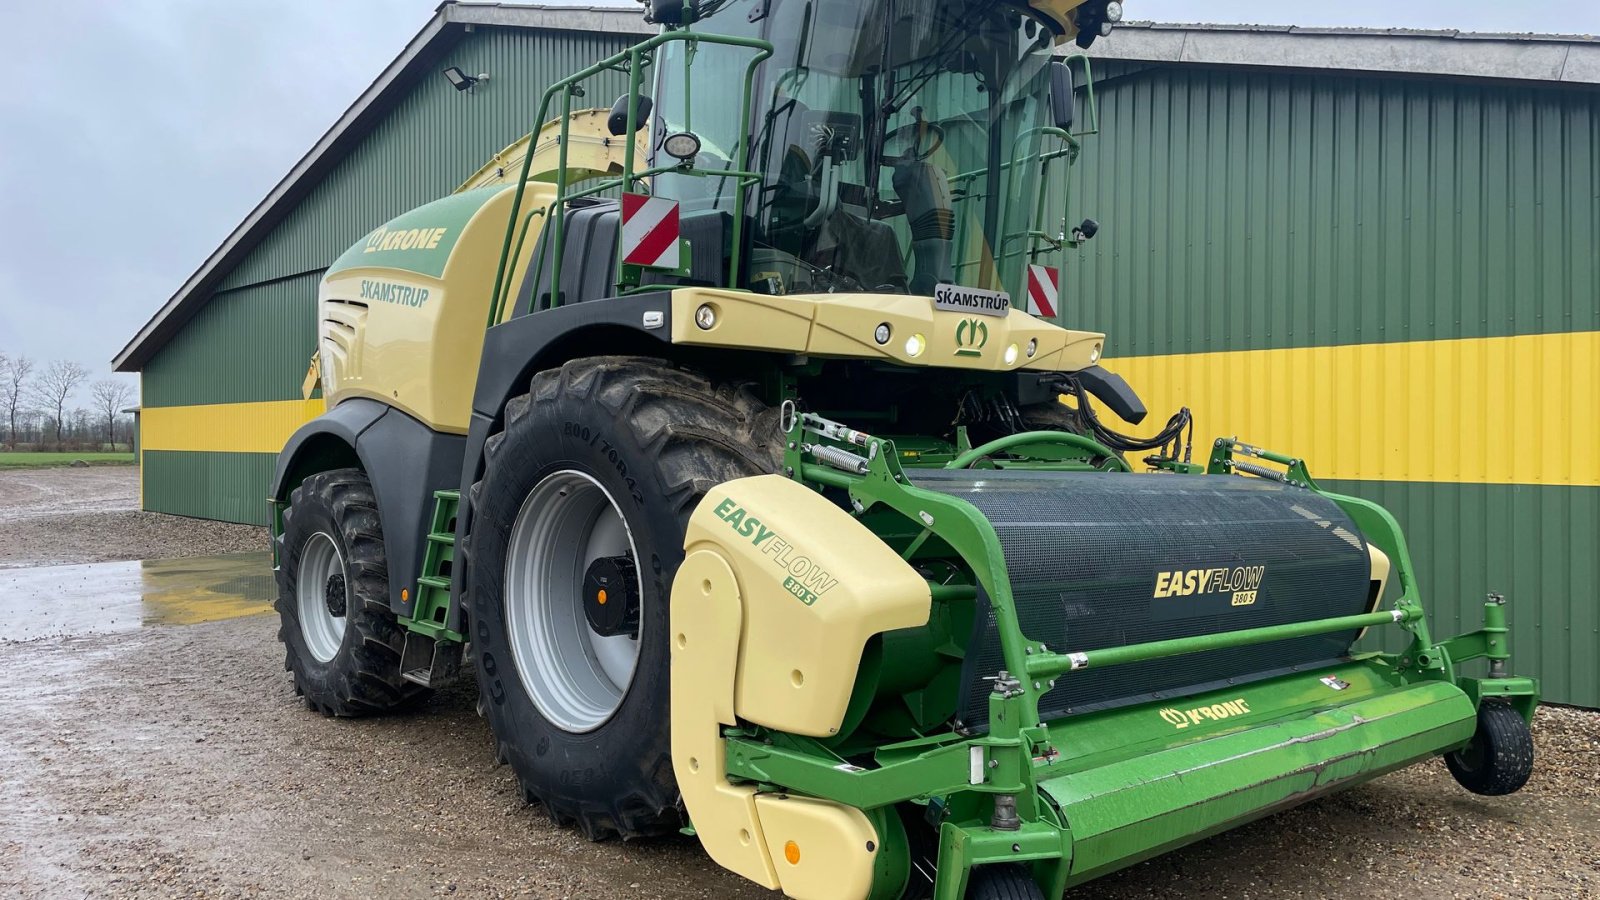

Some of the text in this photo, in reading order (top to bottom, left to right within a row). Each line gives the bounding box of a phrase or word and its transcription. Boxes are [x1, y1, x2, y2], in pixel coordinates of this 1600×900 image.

[377, 228, 447, 251] KRONE
[361, 279, 429, 308] SKAMSTRUP
[713, 497, 839, 596] EASYFLOW
[785, 579, 805, 597] 380
[1153, 565, 1265, 599] EASYFLOW
[1234, 593, 1248, 604] 380
[1185, 698, 1251, 725] KRONE
